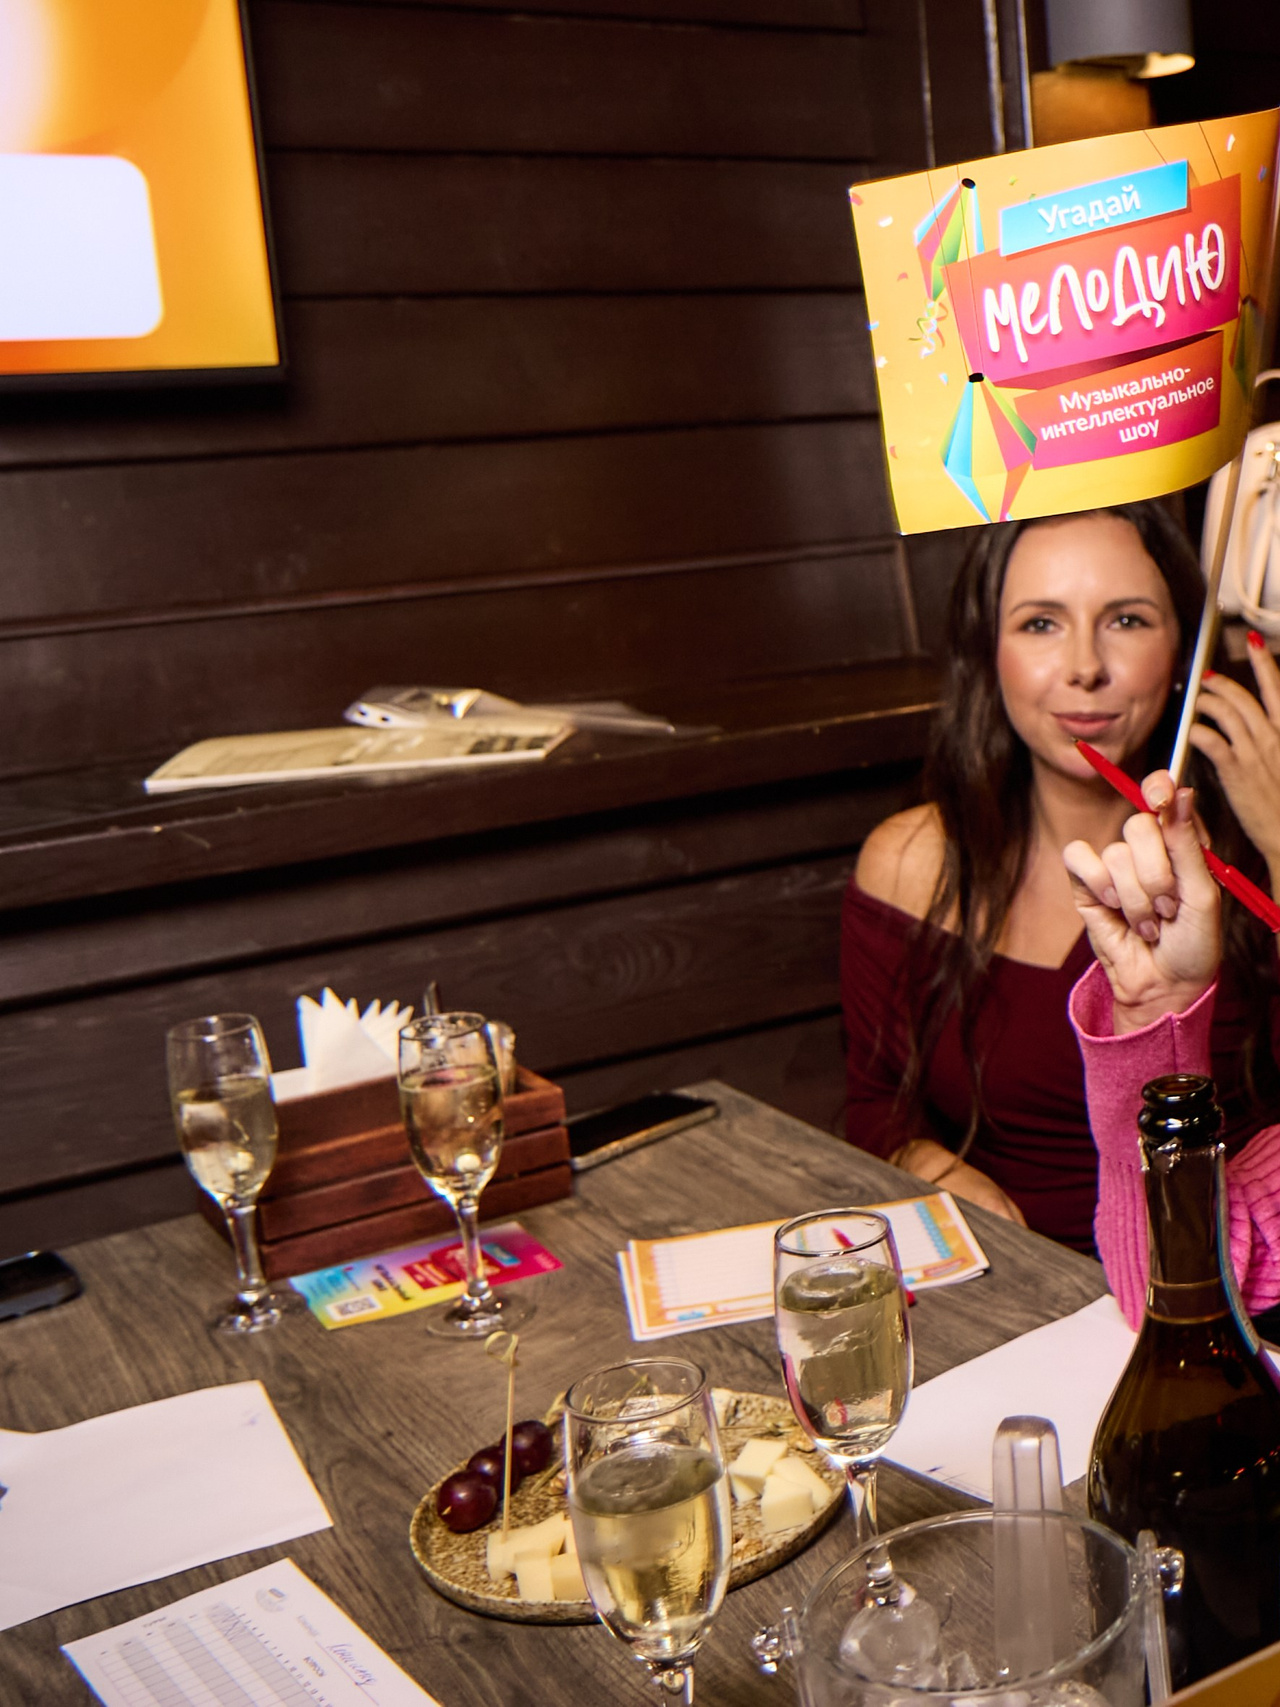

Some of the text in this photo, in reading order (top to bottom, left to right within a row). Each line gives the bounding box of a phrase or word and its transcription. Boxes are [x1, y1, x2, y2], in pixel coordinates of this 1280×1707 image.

[1038, 184, 1142, 233] Угадай
[1040, 376, 1215, 441] интеллектуальное
[1058, 366, 1192, 413] Музыкально-
[1118, 419, 1160, 443] шоу
